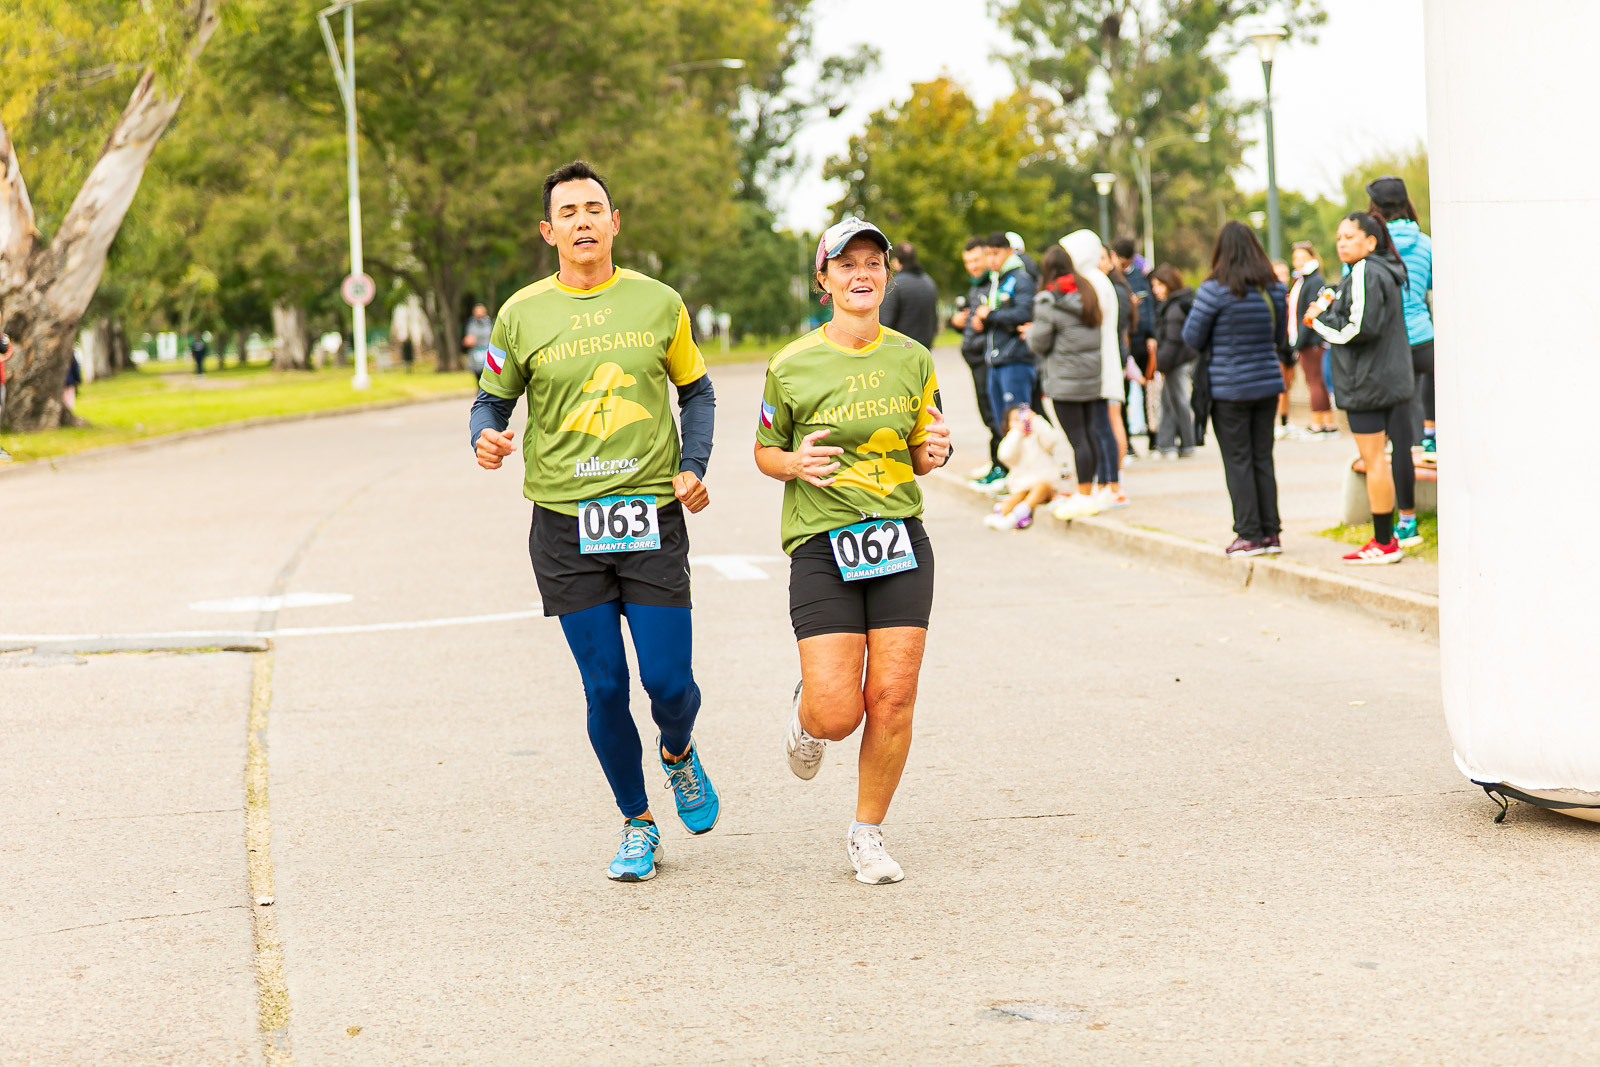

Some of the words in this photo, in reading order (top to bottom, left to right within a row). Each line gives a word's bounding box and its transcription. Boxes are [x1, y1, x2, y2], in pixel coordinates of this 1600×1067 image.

[570, 307, 612, 331] 216°
[536, 331, 656, 367] ANIVERSARIO
[845, 369, 886, 393] 216°
[811, 395, 922, 425] ANIVERSARIO
[573, 455, 639, 478] julicroc
[583, 498, 651, 541] 063
[584, 542, 627, 552] DIAMANTE
[628, 540, 656, 549] CORRE
[837, 521, 907, 569] 062
[846, 567, 885, 579] DIAMANTE
[886, 560, 912, 572] CORRE
